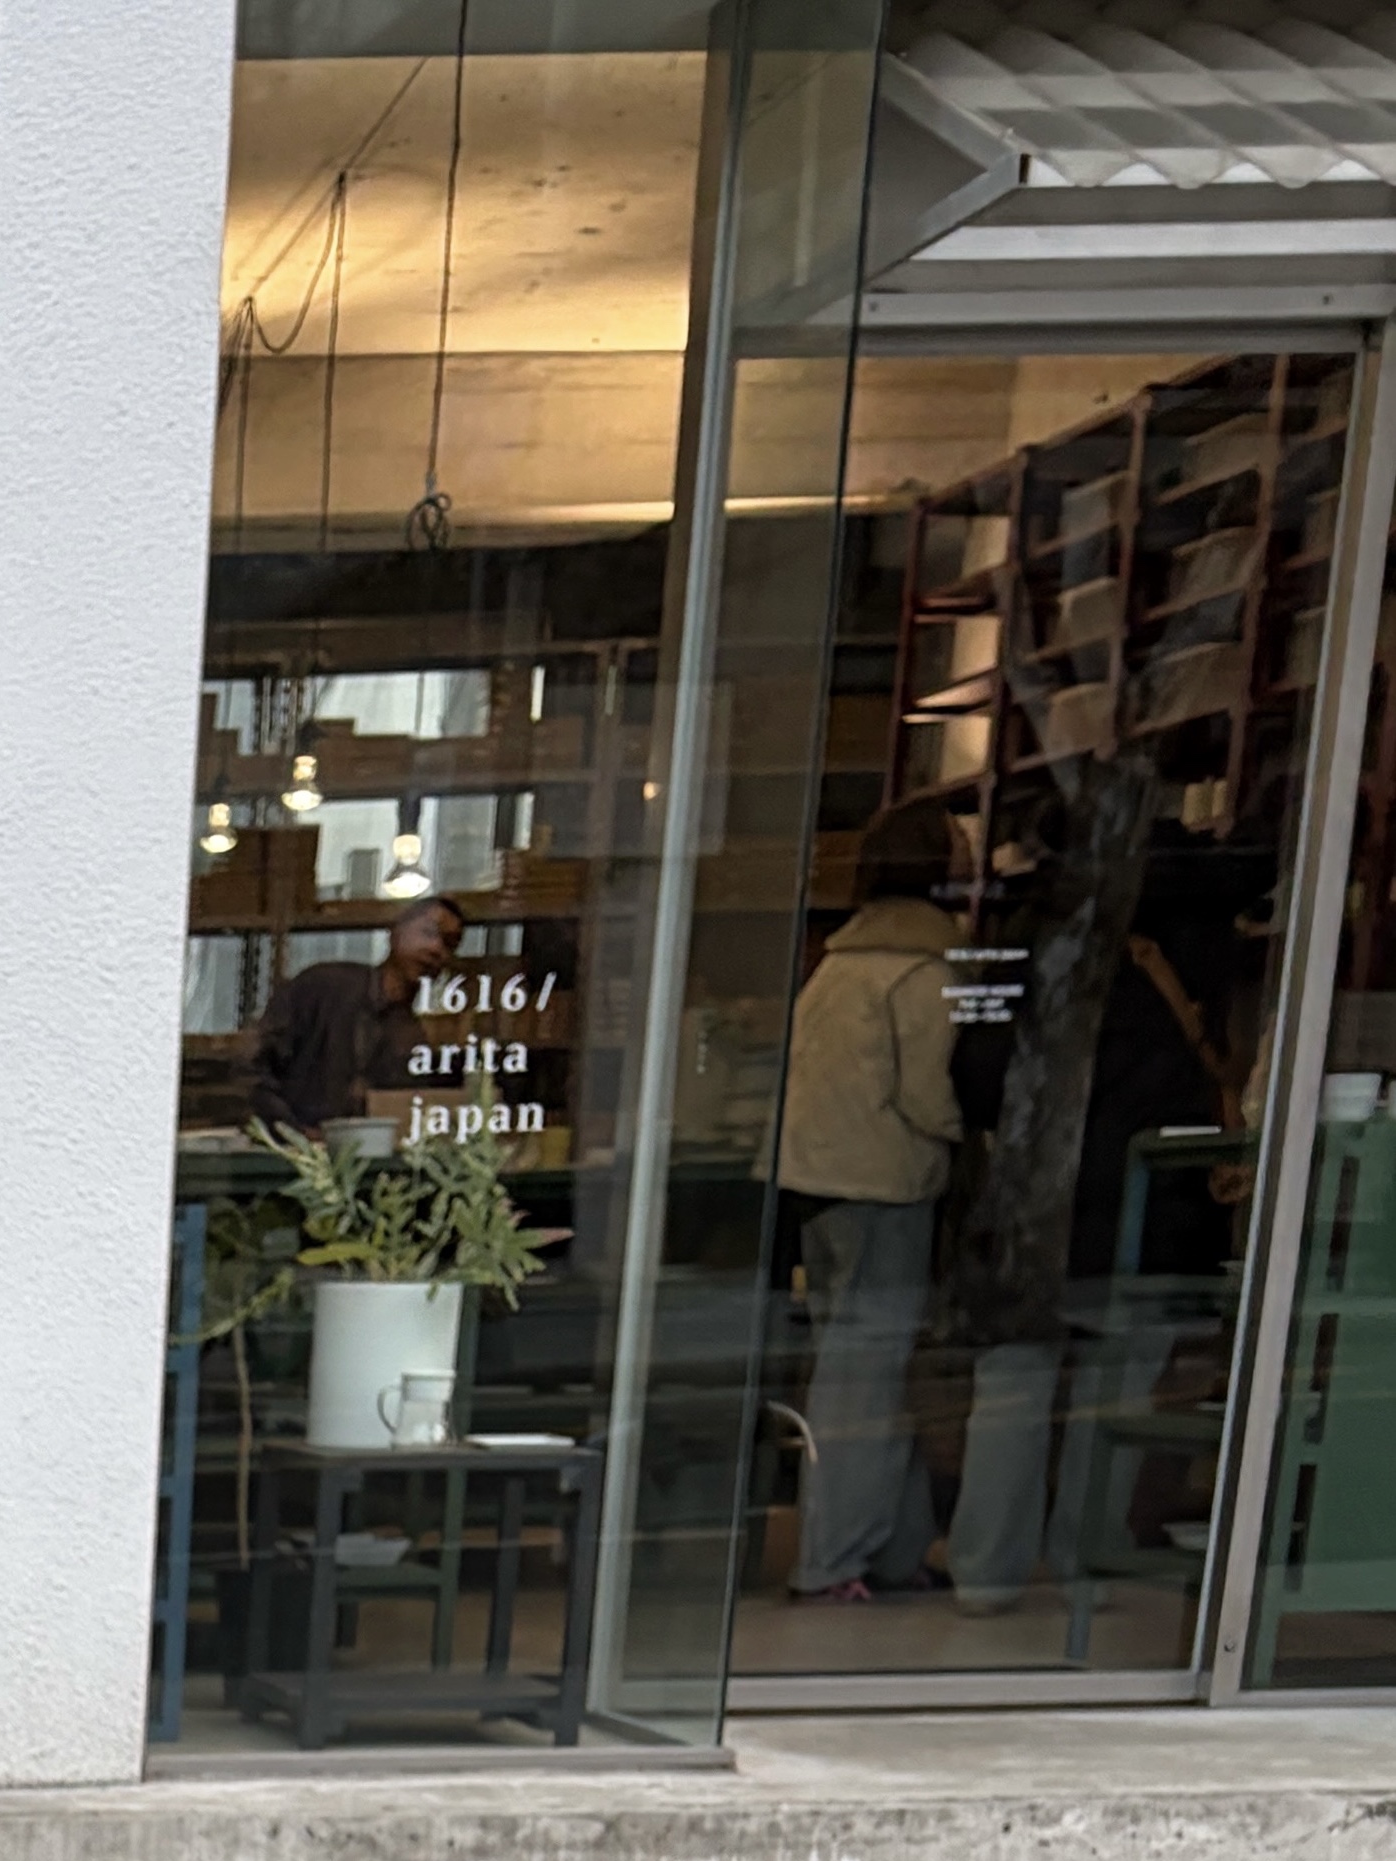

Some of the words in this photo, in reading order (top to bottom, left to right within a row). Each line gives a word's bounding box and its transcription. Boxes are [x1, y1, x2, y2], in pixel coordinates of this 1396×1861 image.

[413, 971, 557, 1014] 1616/
[408, 1033, 529, 1075] arita
[402, 1096, 546, 1147] japan
